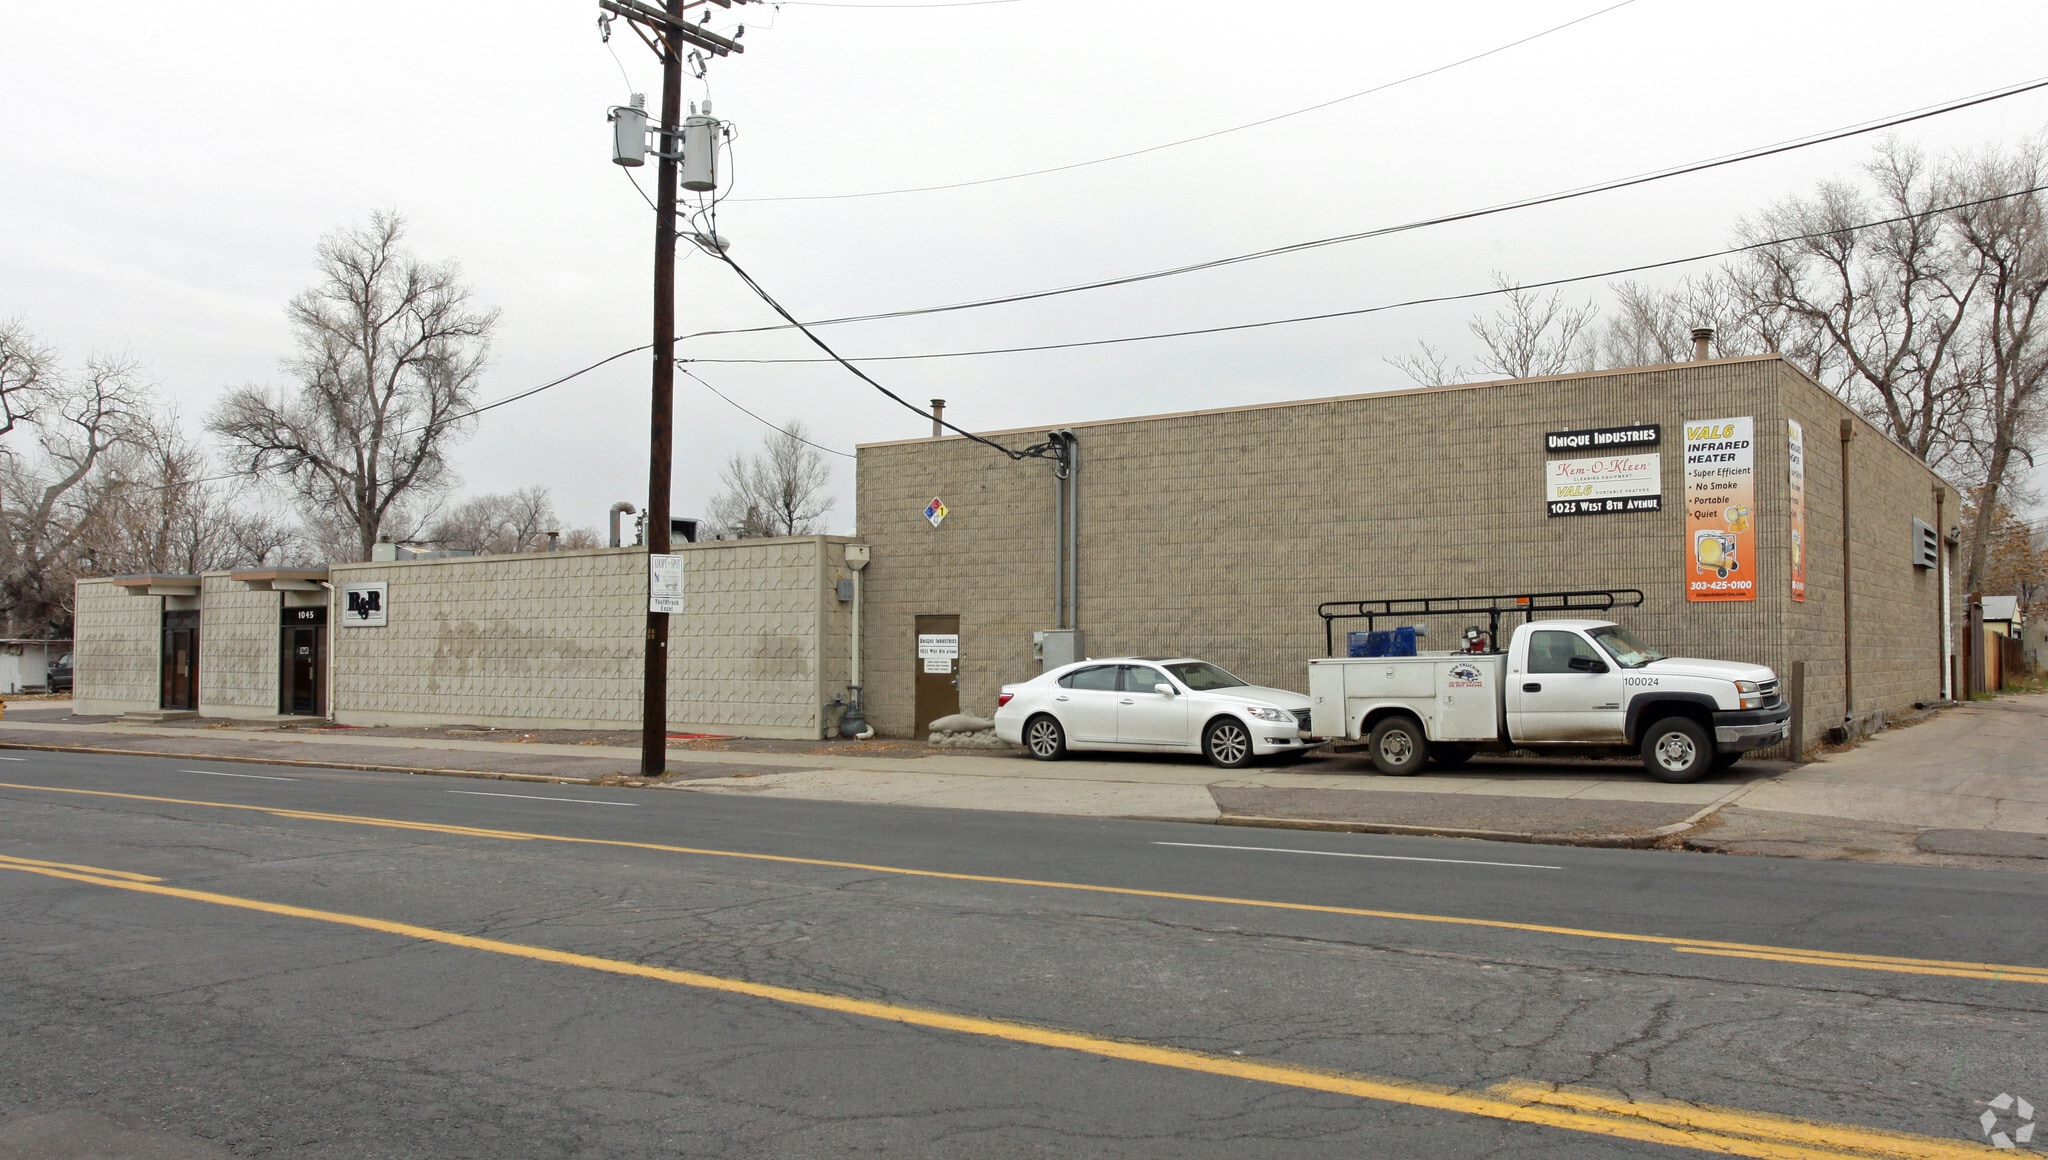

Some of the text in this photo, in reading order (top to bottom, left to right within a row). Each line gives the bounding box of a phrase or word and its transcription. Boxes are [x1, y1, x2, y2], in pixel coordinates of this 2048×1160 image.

[1687, 424, 1735, 440] VAL6
[1549, 430, 1655, 448] UNIQUE INDUSTRIES
[1688, 441, 1749, 452] INFRARED
[1688, 453, 1736, 463] HEATER
[1556, 459, 1647, 477] Kem-O-Kleen
[1694, 468, 1750, 479] Super Efficient
[1557, 484, 1592, 497] VAL6
[1711, 482, 1737, 490] Smoke
[1694, 496, 1729, 504] Portable
[1551, 499, 1658, 513] 1025 WEST 8TH AVENUE
[928, 508, 932, 517] 3
[1690, 581, 1752, 590] 303-425-0100
[1624, 678, 1659, 686] 100024
